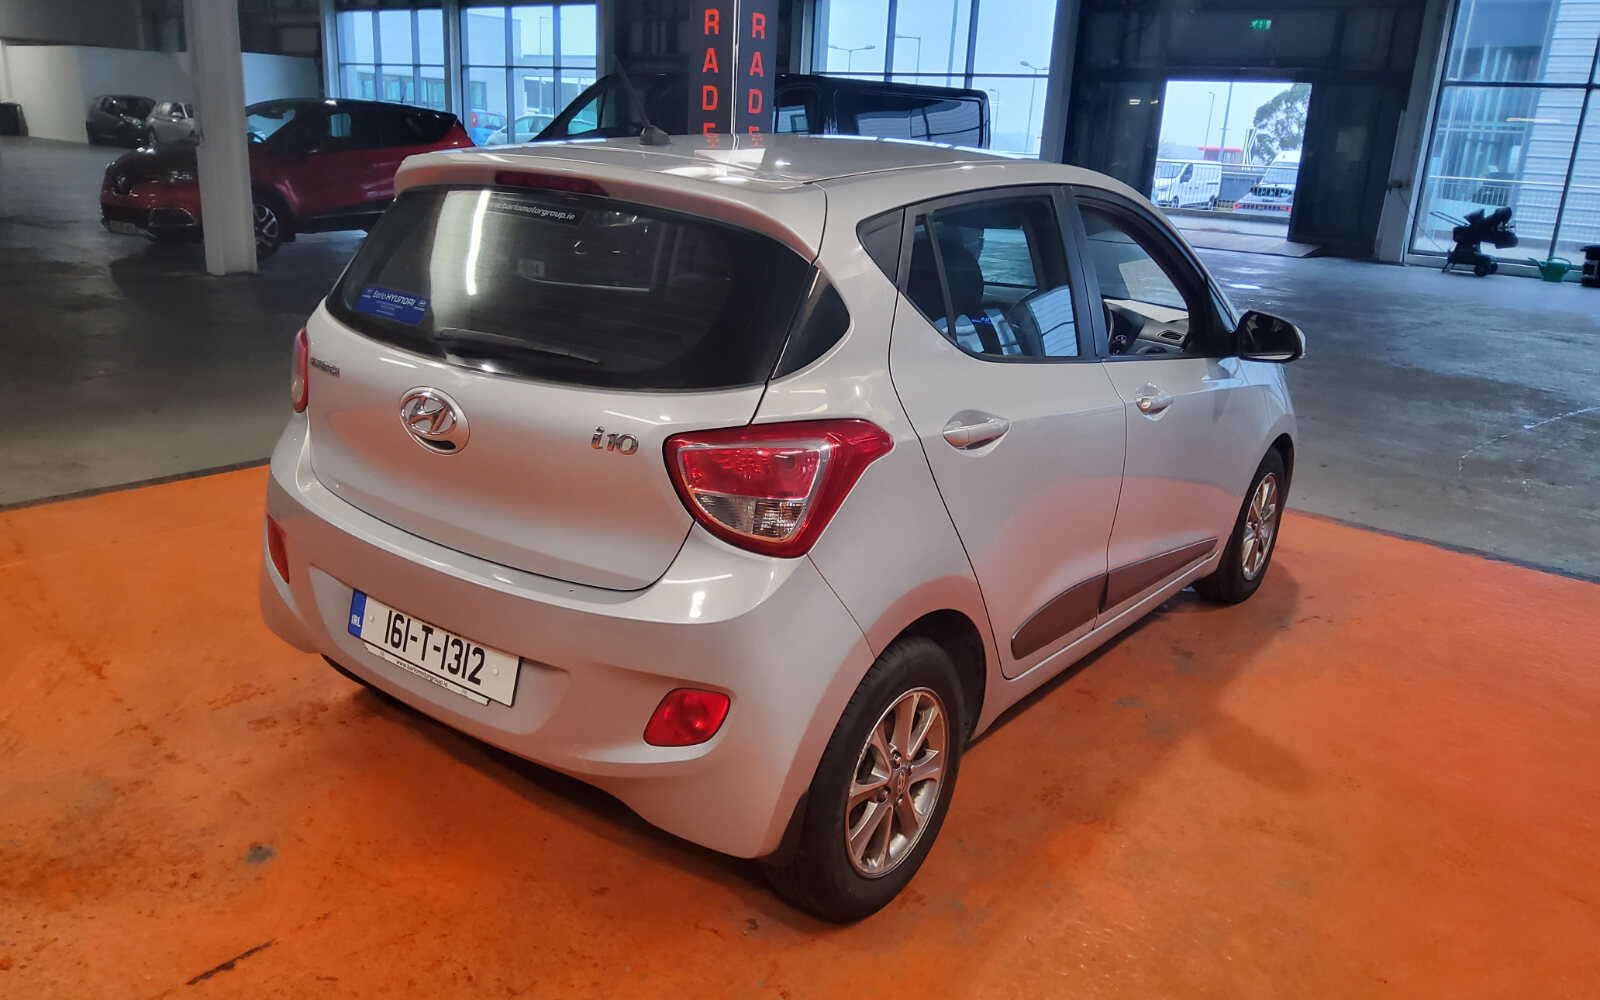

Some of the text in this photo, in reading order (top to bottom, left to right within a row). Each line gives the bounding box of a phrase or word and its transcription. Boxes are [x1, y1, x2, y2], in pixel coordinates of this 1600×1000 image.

[591, 426, 639, 455] i10
[351, 613, 361, 628] IRL
[384, 610, 485, 686] 161-T-1312
